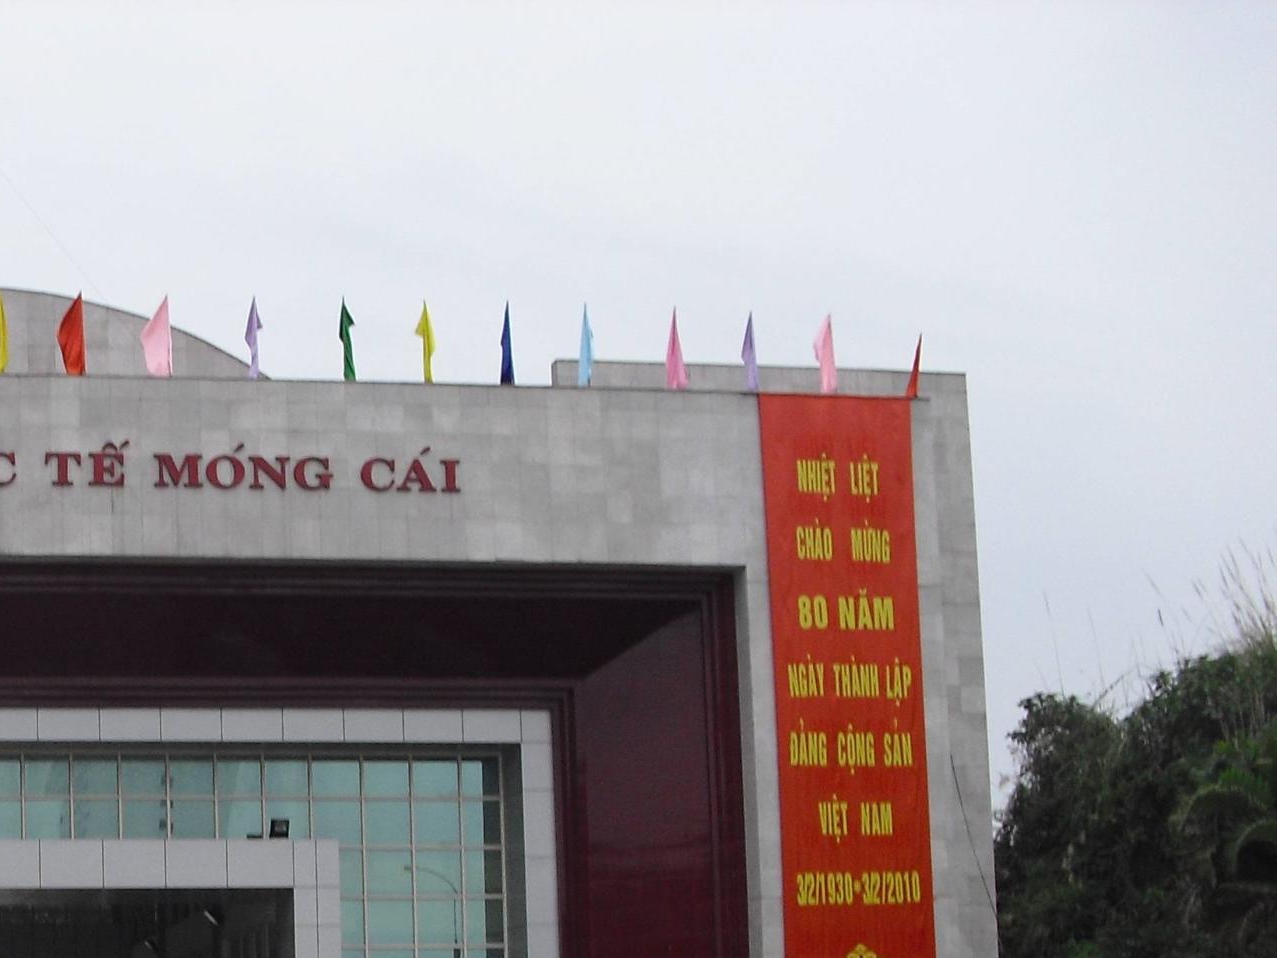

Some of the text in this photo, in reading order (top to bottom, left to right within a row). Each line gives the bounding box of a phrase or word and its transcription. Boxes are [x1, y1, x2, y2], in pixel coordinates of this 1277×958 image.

[45, 440, 129, 488] TẾ
[153, 443, 333, 491] MÓNG
[360, 447, 461, 493] CÁI
[796, 452, 879, 503] NHIỆT LIỆT
[796, 517, 833, 561] CHÀO
[798, 588, 895, 631] 80 NĂM
[788, 654, 912, 707] NGÀY THÀNH LẬP
[837, 723, 876, 775] CỘNG
[819, 794, 893, 843] VIỆT NAM
